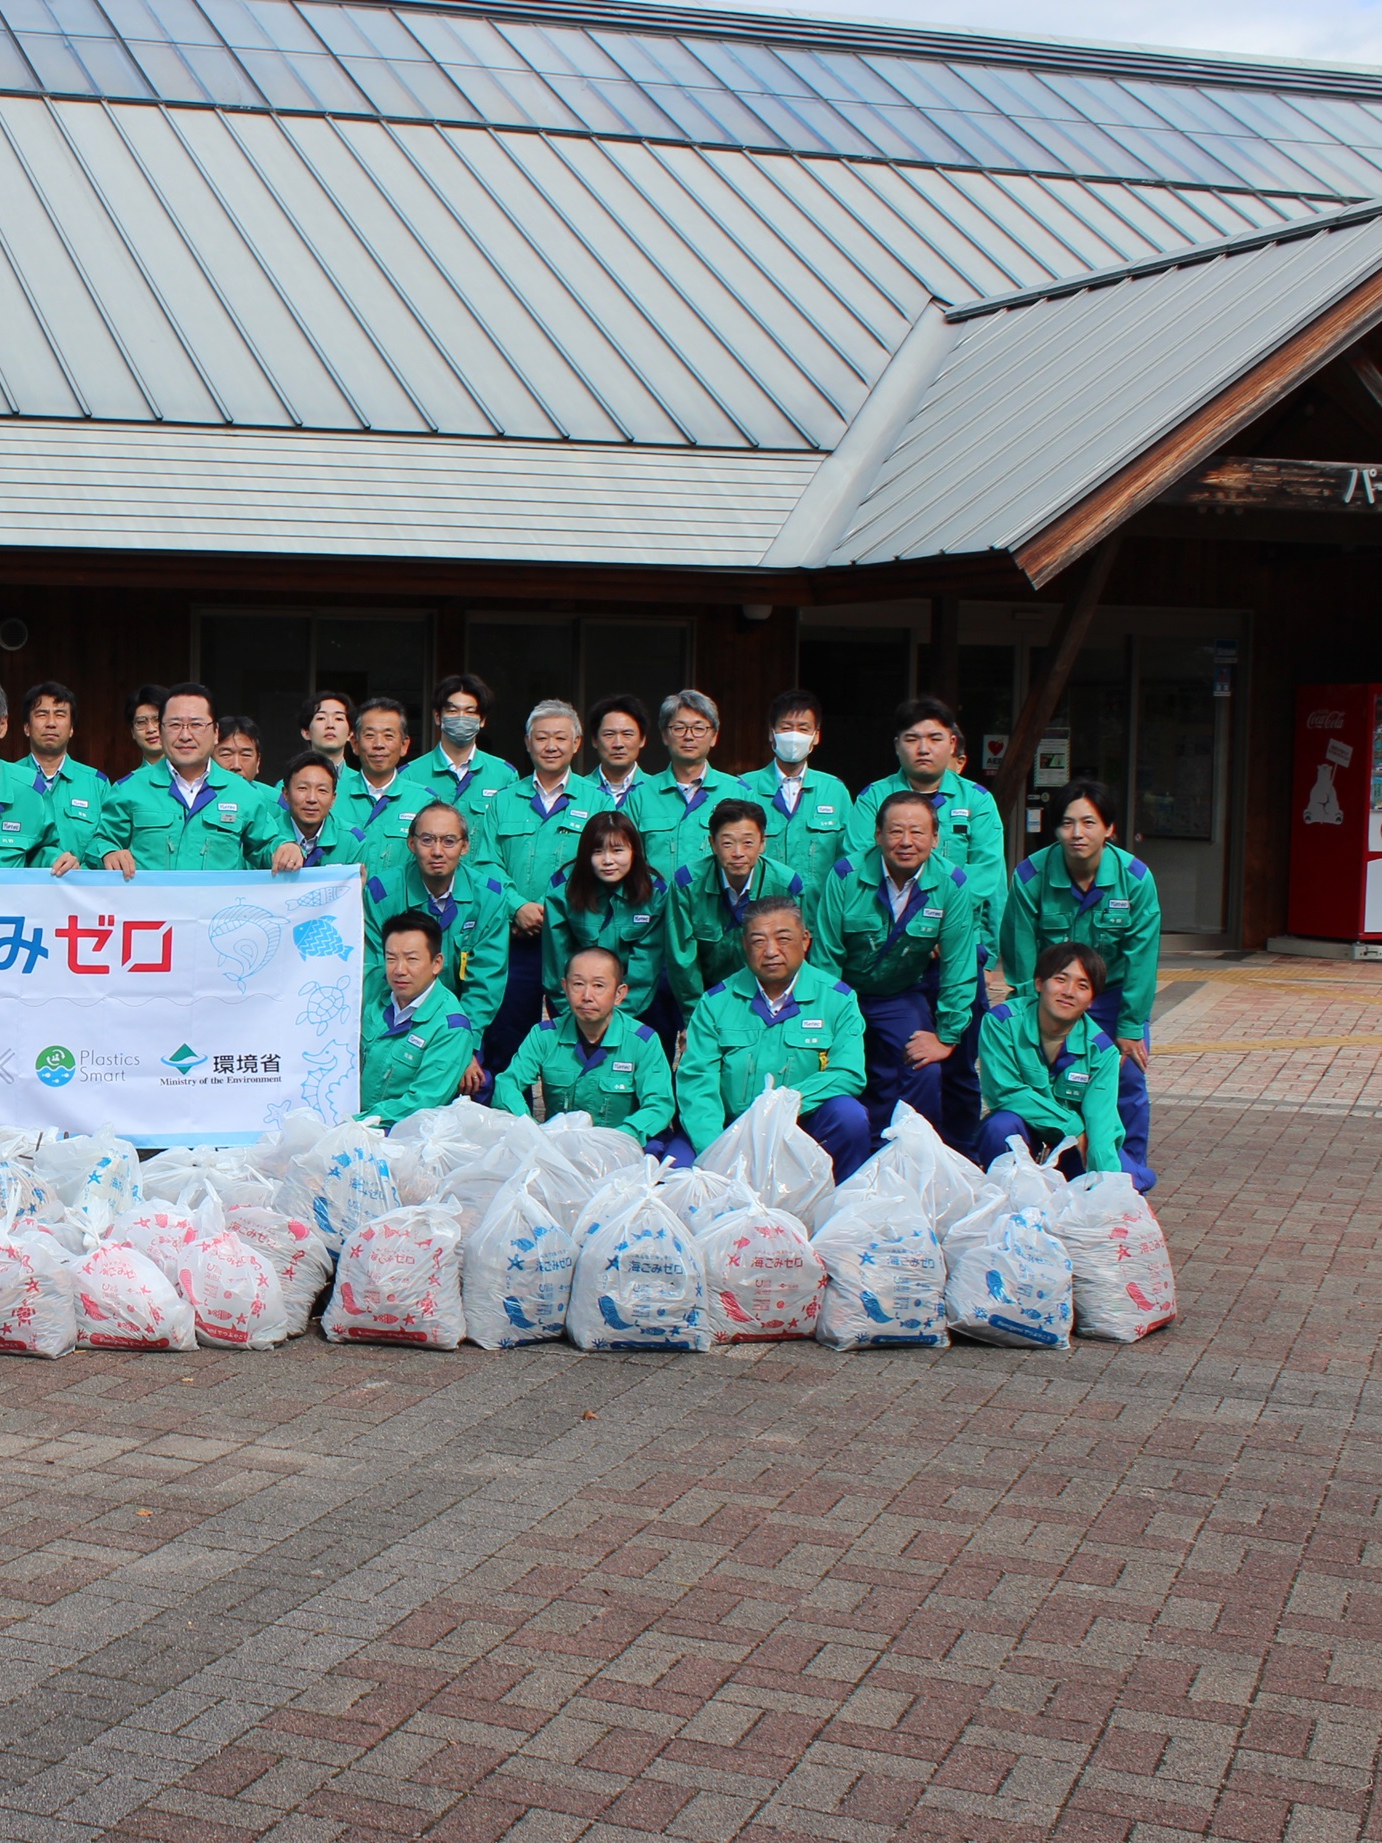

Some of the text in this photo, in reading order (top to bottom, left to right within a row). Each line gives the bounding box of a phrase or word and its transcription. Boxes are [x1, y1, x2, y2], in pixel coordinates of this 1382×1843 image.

[1343, 468, 1382, 503] パ
[80, 1049, 140, 1067] Plastics
[213, 1054, 281, 1075] 環境省
[79, 1066, 126, 1083] Smart
[160, 1075, 282, 1087] Ministry of the Environment
[629, 1259, 684, 1275] 海ごみゼロ
